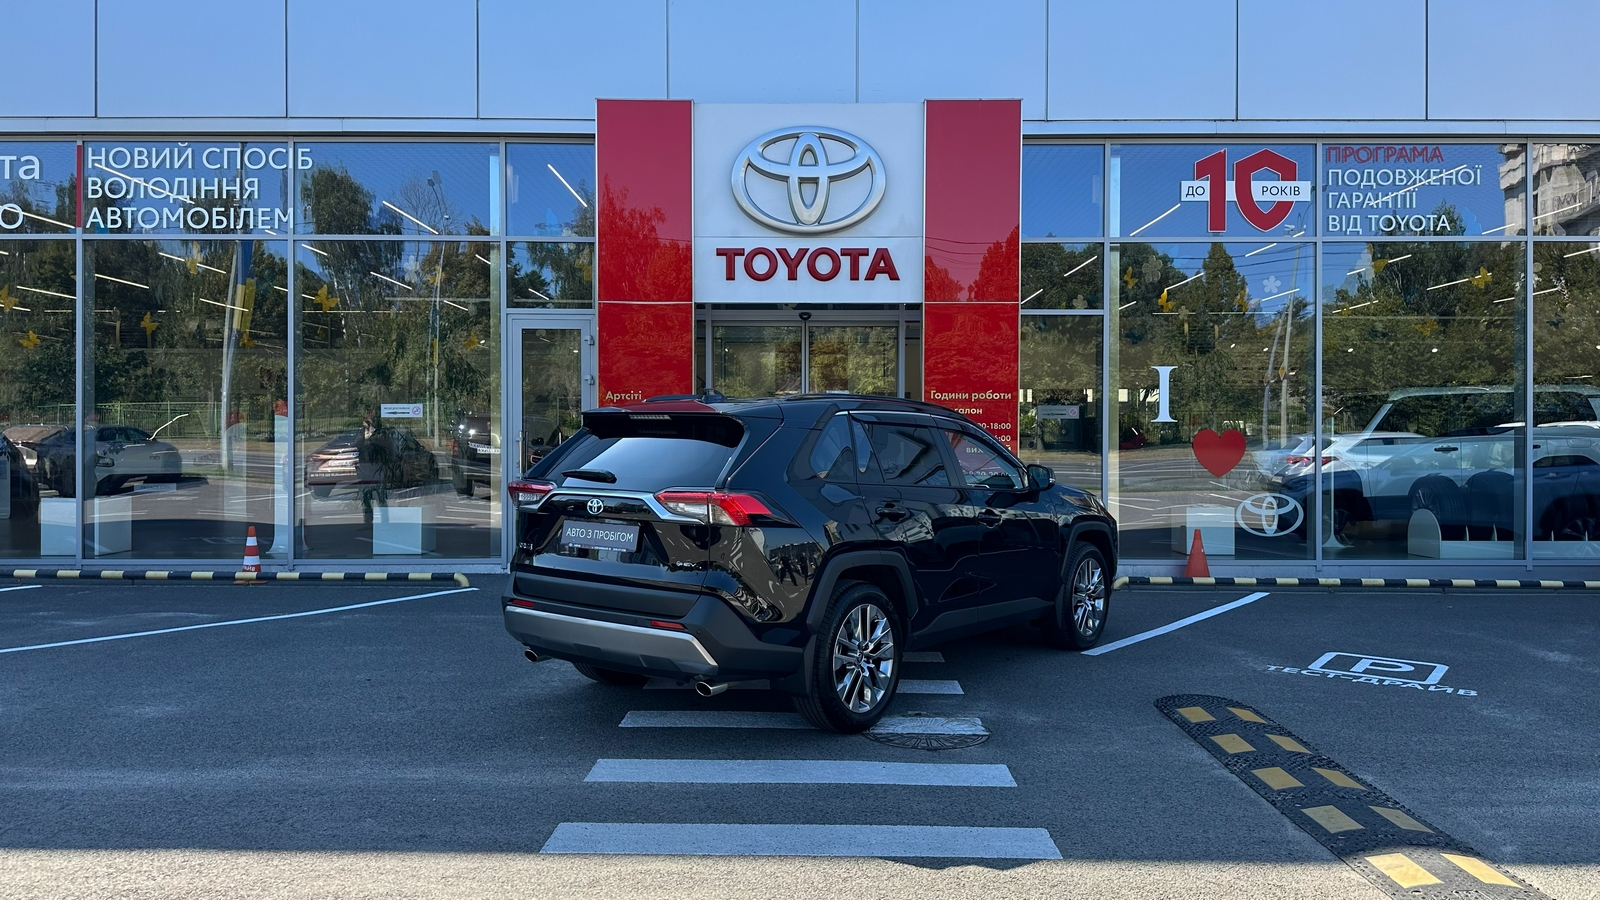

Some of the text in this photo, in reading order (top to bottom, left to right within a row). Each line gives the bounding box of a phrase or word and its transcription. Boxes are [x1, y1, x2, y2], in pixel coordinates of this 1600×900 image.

[88, 141, 314, 171] НОВИЙ СПОСІБ
[1327, 145, 1445, 163] ПРОГРАМА
[1328, 165, 1482, 187] ПОДОВЖЕНОЇ
[87, 177, 259, 203] ВОЛОДІННЯ
[1185, 185, 1301, 198] ДО РОКІВ
[1328, 188, 1418, 209] ГАРАНТІЇ
[86, 206, 294, 230] АВТОМОБІЛЕМ
[1328, 213, 1451, 235] ВІД TOYOTA
[716, 247, 900, 282] TOYOTA
[605, 390, 642, 403] Артсіті
[930, 388, 1012, 402] Години роботи
[565, 528, 586, 538] АВТО
[593, 530, 634, 542] ПРОБІГОМ
[1266, 665, 1478, 697] ТЕСТ-ДРАЙВ
